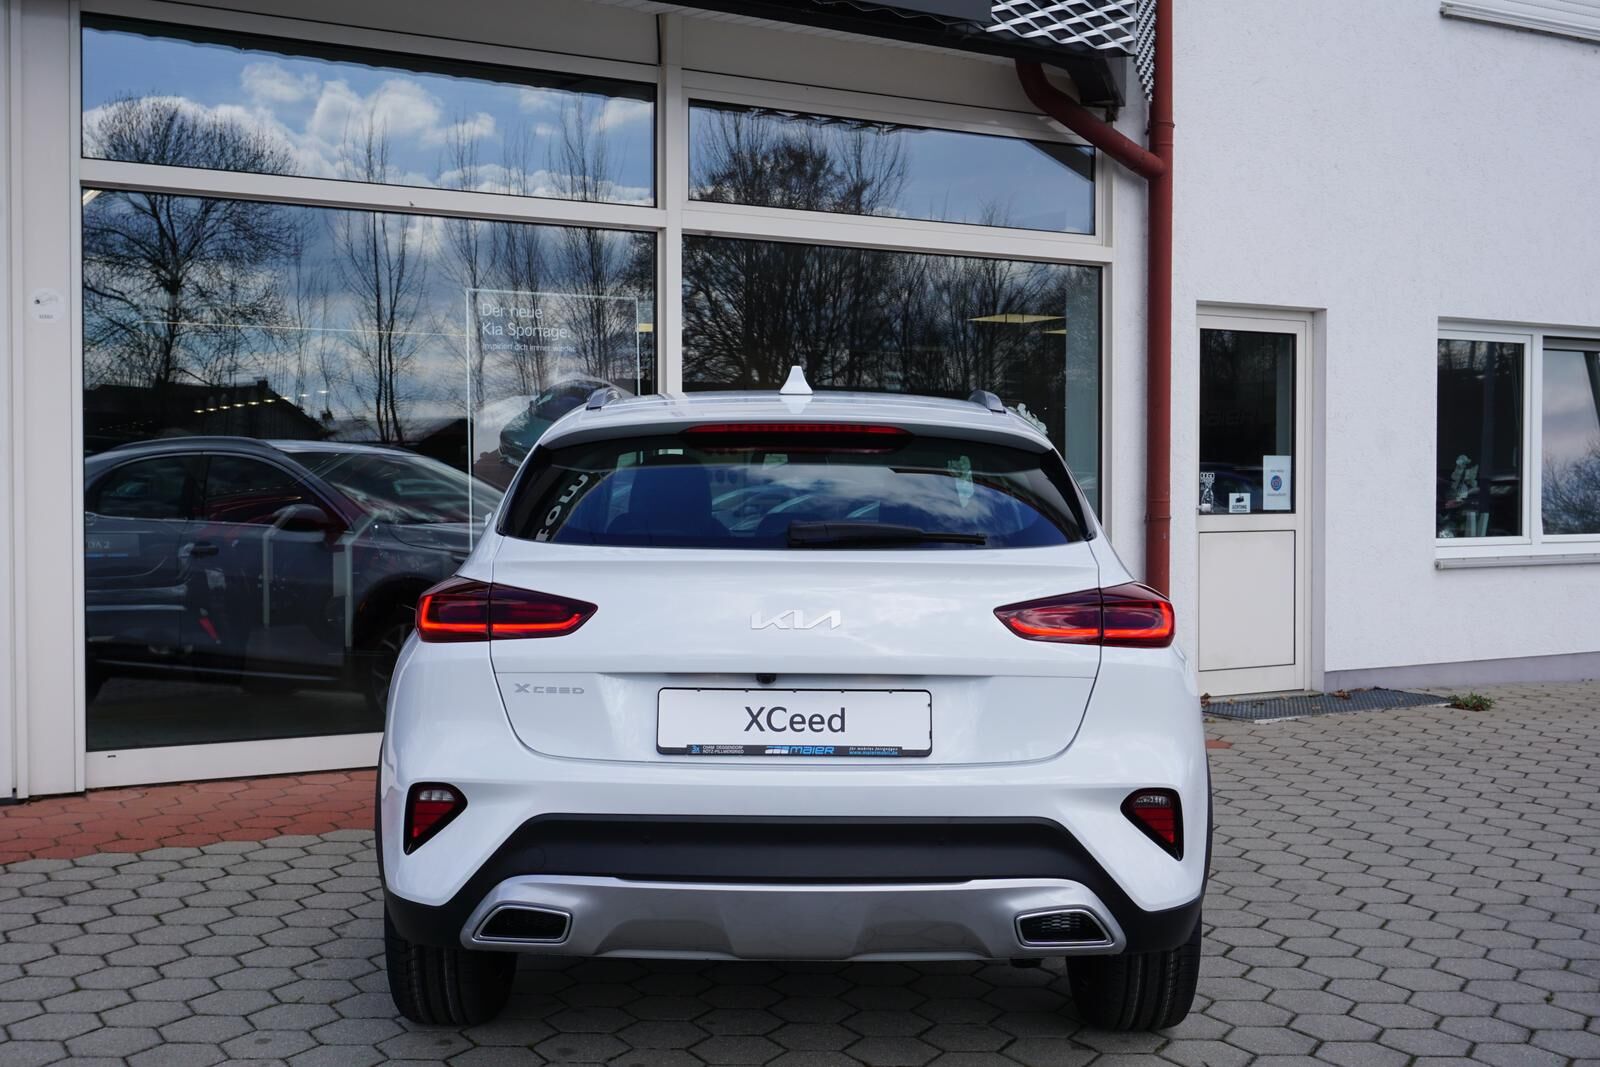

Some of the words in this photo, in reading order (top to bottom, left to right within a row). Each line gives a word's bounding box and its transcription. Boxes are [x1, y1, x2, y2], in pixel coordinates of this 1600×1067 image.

[482, 303, 505, 317] Der
[511, 306, 543, 319] neue
[482, 322, 503, 336] Kia
[508, 322, 571, 341] Sportage.
[751, 609, 841, 630] KIA
[743, 706, 847, 733] XCeed
